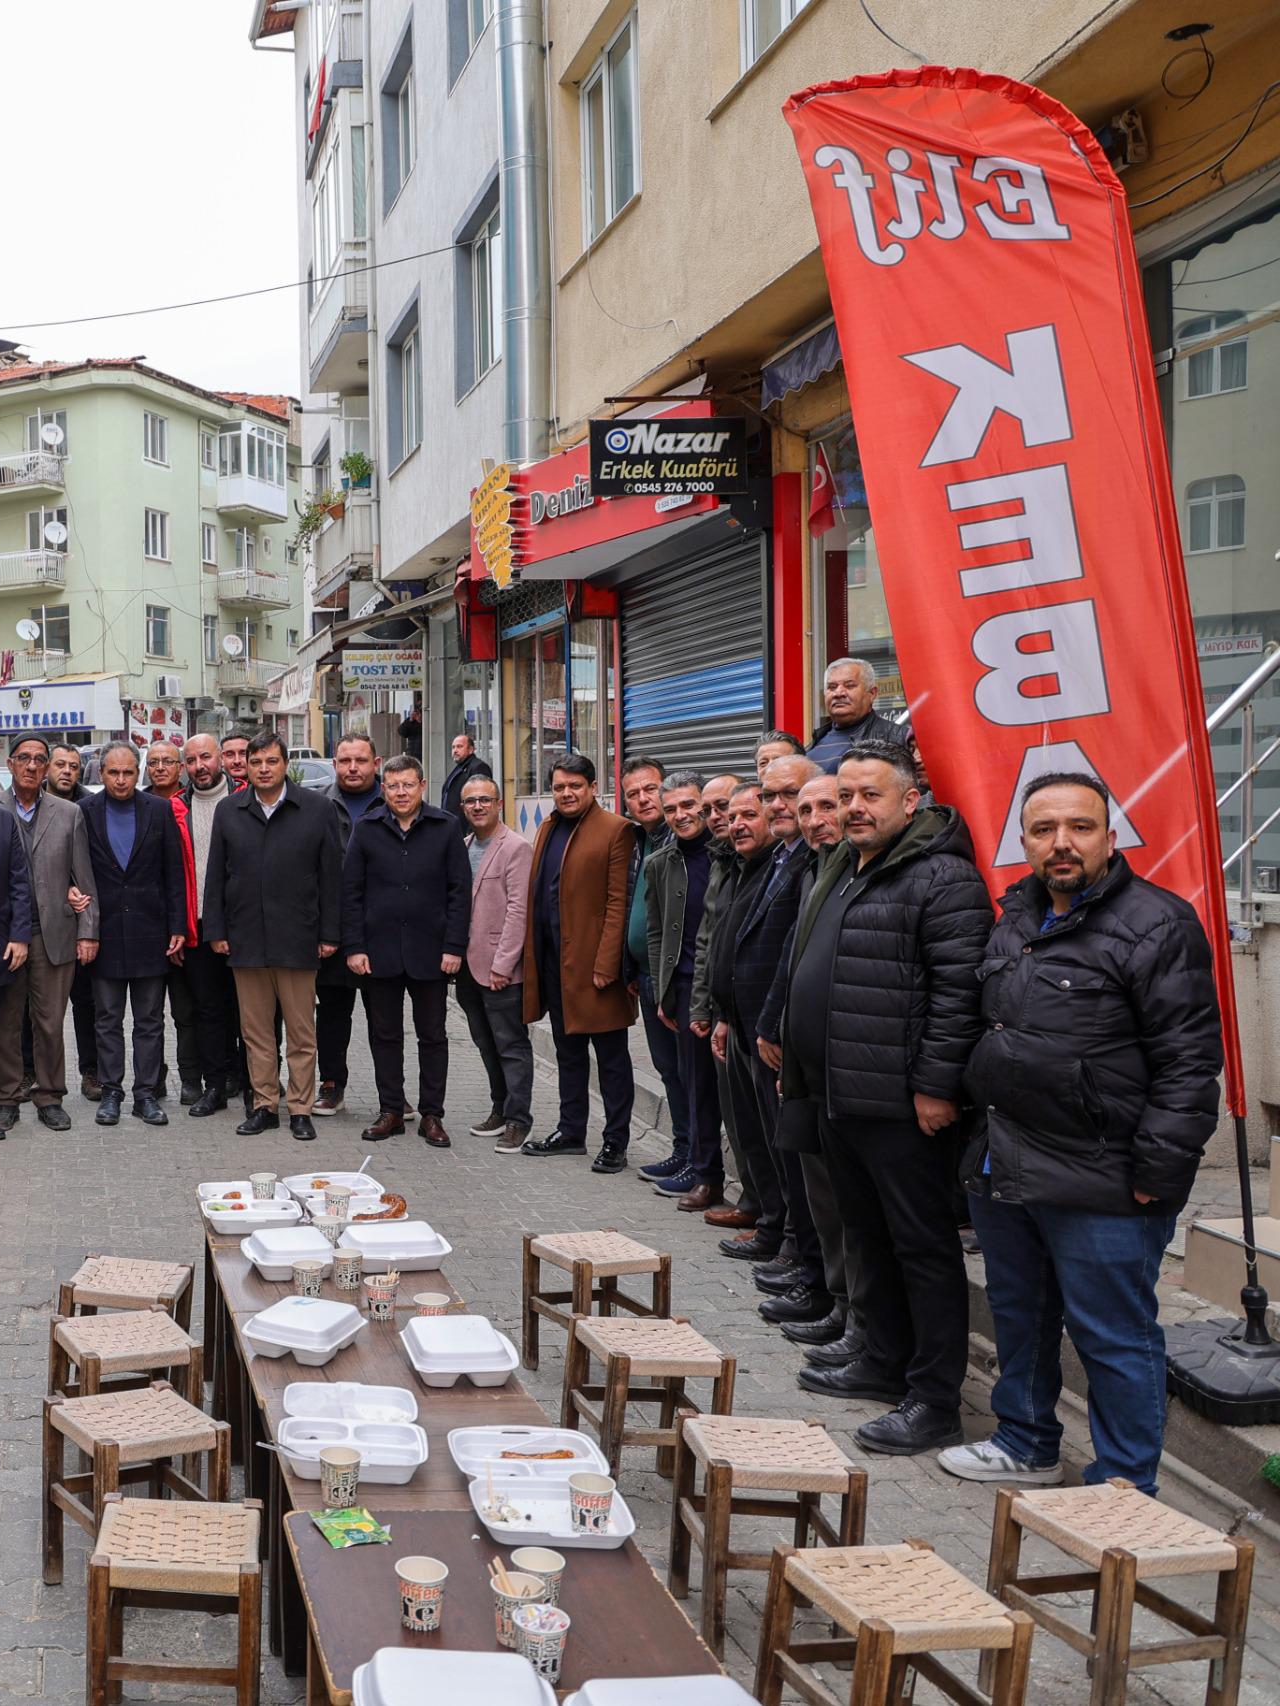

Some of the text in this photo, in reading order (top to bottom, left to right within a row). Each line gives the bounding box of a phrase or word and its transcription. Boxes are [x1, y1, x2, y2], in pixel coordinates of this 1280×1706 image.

[627, 423, 730, 454] Nazar
[600, 457, 738, 480] Erkek Kuaförü
[475, 465, 507, 509] ADANA
[634, 481, 715, 494] 0545 276 7000
[530, 474, 594, 526] Deniz
[351, 662, 416, 675] TOST EVİ
[32, 711, 84, 726] KASABI
